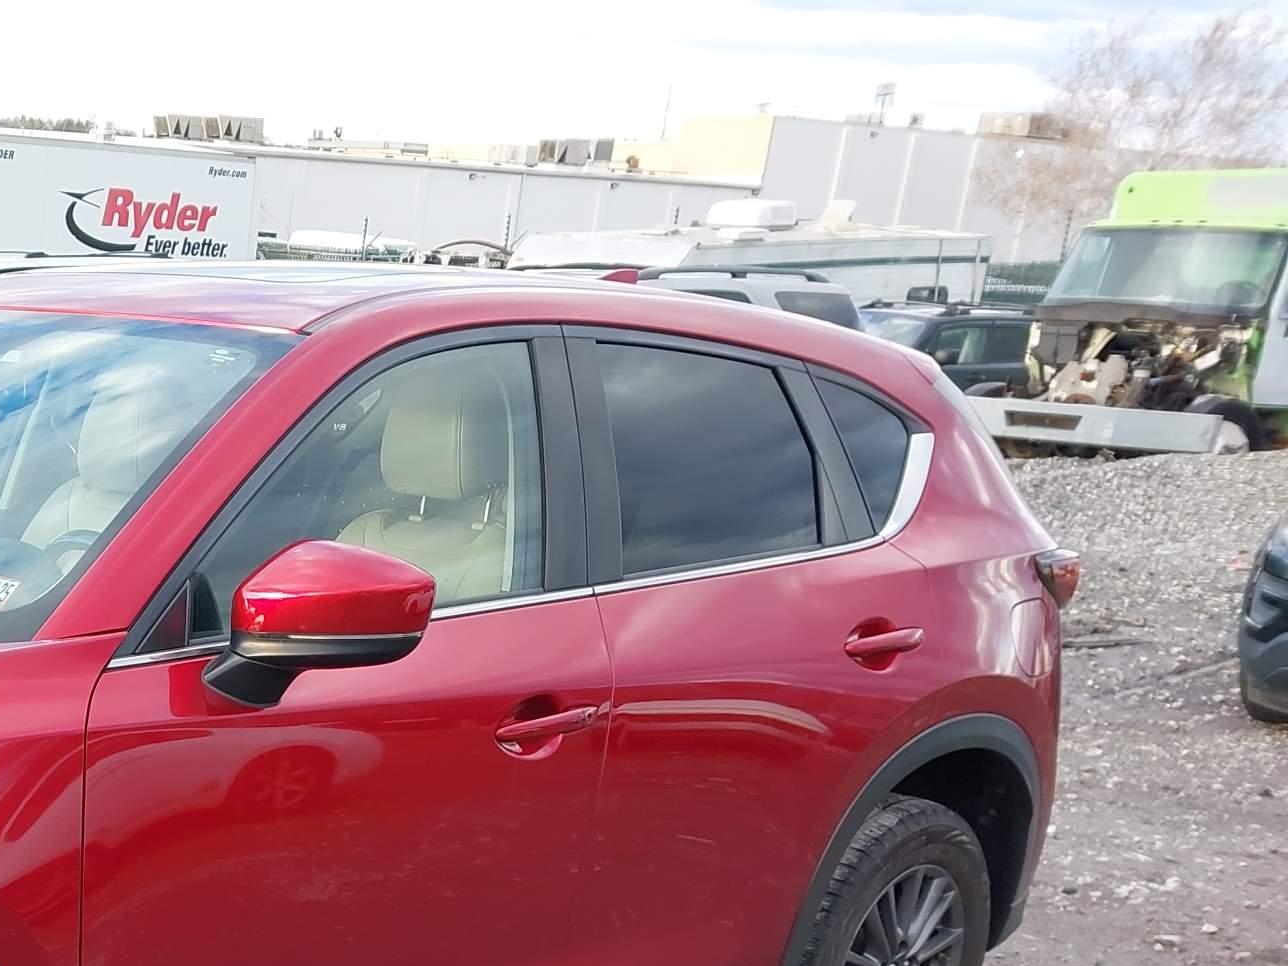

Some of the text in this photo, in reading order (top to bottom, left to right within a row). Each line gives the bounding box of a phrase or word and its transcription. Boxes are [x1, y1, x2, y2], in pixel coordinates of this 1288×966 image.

[208, 165, 248, 178] Ryder.com
[101, 187, 218, 239] Ryder
[143, 234, 228, 259] Ever better.
